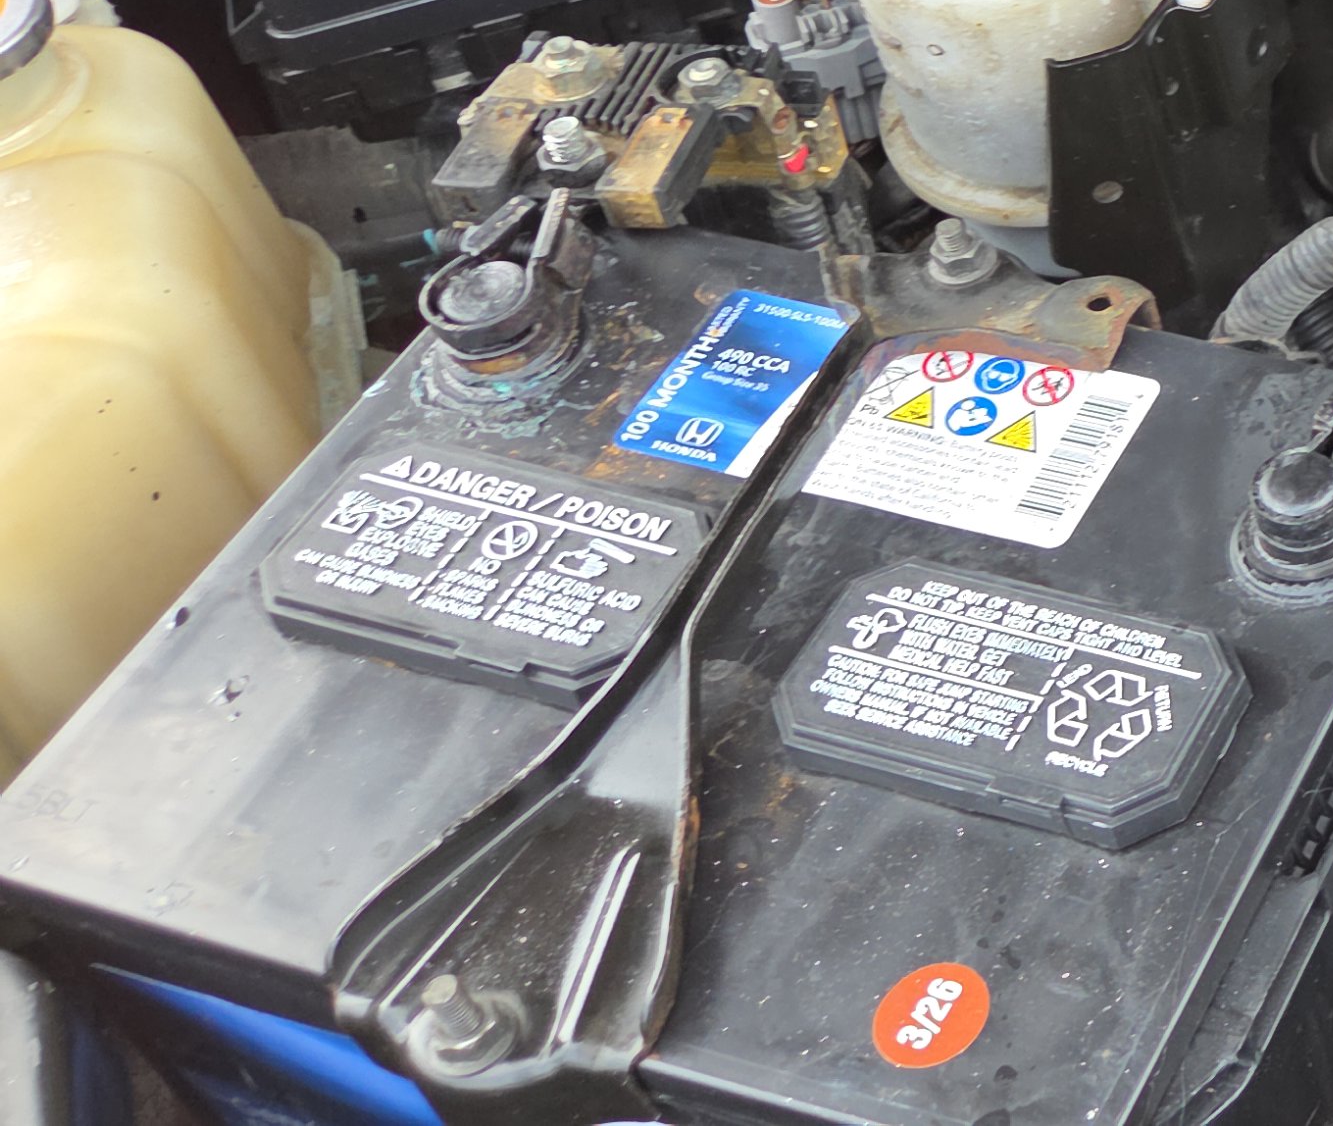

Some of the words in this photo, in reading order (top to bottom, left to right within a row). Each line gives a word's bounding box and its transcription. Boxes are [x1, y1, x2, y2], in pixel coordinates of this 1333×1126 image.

[717, 348, 753, 366] 490
[752, 355, 791, 373] CCA
[620, 410, 660, 443] 100
[646, 335, 720, 409] MONTH
[859, 403, 880, 416] Pb
[651, 440, 717, 462] HONDA
[409, 460, 537, 510] DANGER
[554, 495, 672, 542] POISON
[418, 505, 477, 532] SHIELD
[357, 526, 445, 559] EXPLOSIVE
[404, 520, 450, 542] EYES
[294, 548, 325, 565] CAN
[319, 554, 363, 576] CAUSE
[355, 564, 422, 590] BLINDNESS
[345, 542, 399, 567] GASES
[468, 556, 502, 576] NO
[316, 570, 336, 585] OR
[334, 575, 383, 595] INJURY
[514, 586, 551, 604] CAN
[545, 594, 596, 616] CAUSE
[527, 570, 605, 603] SULFURIC
[598, 590, 642, 612] ACID
[492, 612, 549, 637] SEVERE
[543, 627, 594, 648] BURNS
[504, 599, 579, 629] BLINDNESS
[579, 618, 606, 634] OR
[887, 586, 913, 602] DO
[909, 592, 943, 610] NOT
[965, 605, 1003, 623] KEEP
[1001, 614, 1039, 632] VENT
[1035, 623, 1075, 641] CAPS
[1073, 631, 1117, 649] TIGHT
[1112, 641, 1146, 657] AND
[1142, 649, 1184, 668] LEVEL
[920, 580, 960, 597] KEEP
[956, 588, 989, 606] OUT
[985, 596, 1010, 609] OF
[1007, 601, 1039, 618] THE
[1036, 607, 1083, 630] REACH
[1078, 618, 1103, 633] OF
[1099, 624, 1167, 649] CHILDREN
[898, 629, 939, 649] WITH
[978, 648, 1012, 667] GET
[907, 613, 956, 636] FLUSH
[949, 624, 989, 644] EYES
[981, 631, 1068, 662] IMMEDIATELY
[887, 644, 945, 671] MEDICAL
[945, 657, 982, 679] HELP
[974, 665, 1015, 686] FAST
[821, 667, 875, 692] FOLLOW
[868, 681, 957, 712] INSTRUCTIONS
[950, 701, 968, 714] IN
[965, 704, 1019, 726] VEHICLE
[878, 668, 909, 685] FOR
[904, 674, 943, 692] SAFE
[934, 683, 973, 699] JUMP
[968, 689, 1031, 713] STARTING
[1153, 684, 1173, 733] RETURN
[823, 699, 858, 718] SEEK
[854, 705, 910, 731] SERVICE
[901, 721, 978, 747] ASSISTANCE
[909, 705, 930, 719] IF
[925, 708, 954, 725] NOT
[948, 715, 1015, 741] AVAILABLE
[1044, 750, 1110, 778] RECYCLE
[895, 976, 964, 1051] 3/26
